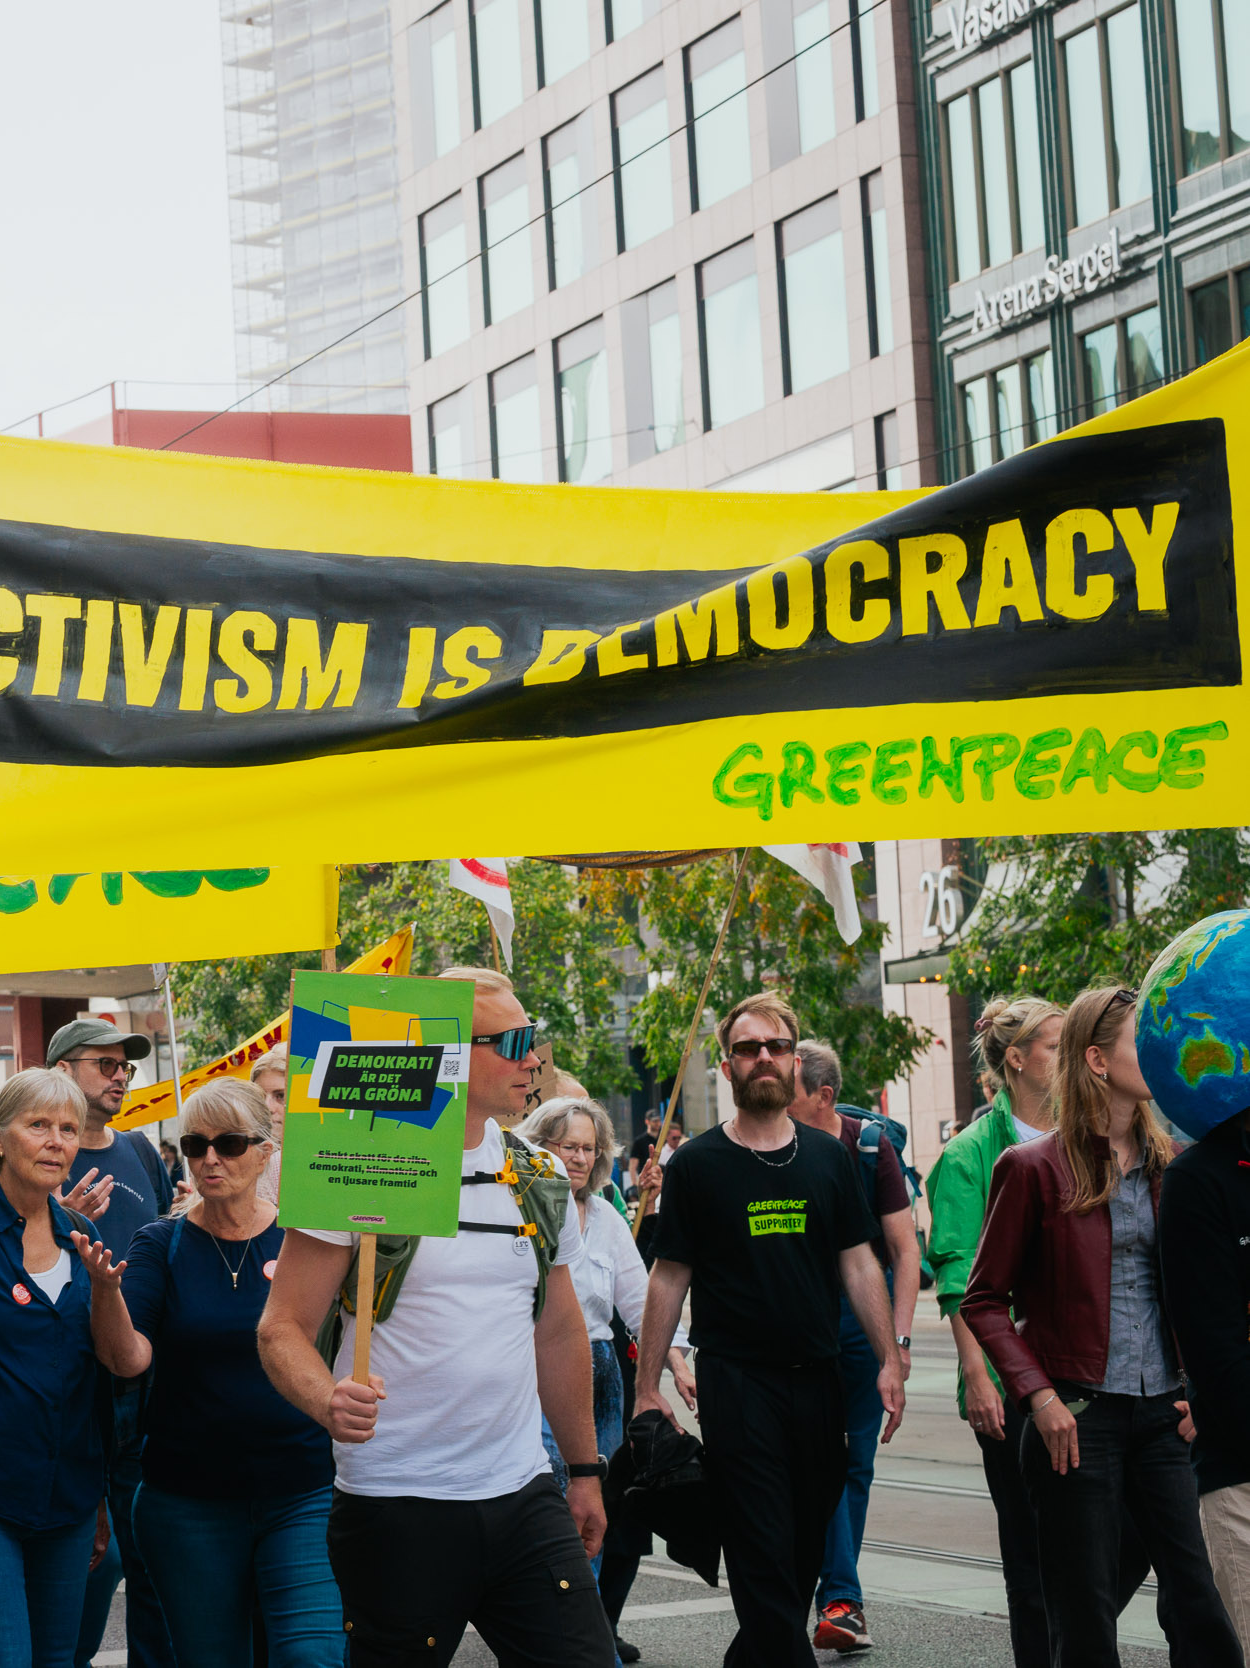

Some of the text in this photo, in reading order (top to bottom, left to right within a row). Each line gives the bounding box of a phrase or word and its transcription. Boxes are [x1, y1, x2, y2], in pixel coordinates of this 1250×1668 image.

[971, 227, 1122, 335] Arena Sergel
[397, 625, 503, 708] IS
[523, 501, 1181, 687] DEMOCRACY
[713, 719, 1229, 821] GREENPEACE
[919, 865, 961, 938] 26
[335, 1054, 434, 1070] DEMOKRATI
[359, 1071, 402, 1083] ÄR DET
[328, 1085, 422, 1102] NYA GRÖNA
[309, 1162, 365, 1174] demokrati,
[419, 1169, 437, 1177] och
[328, 1175, 417, 1188] en ljusare framtid
[747, 1199, 807, 1213] GREENPEACE
[754, 1218, 801, 1231] SUPPORTER
